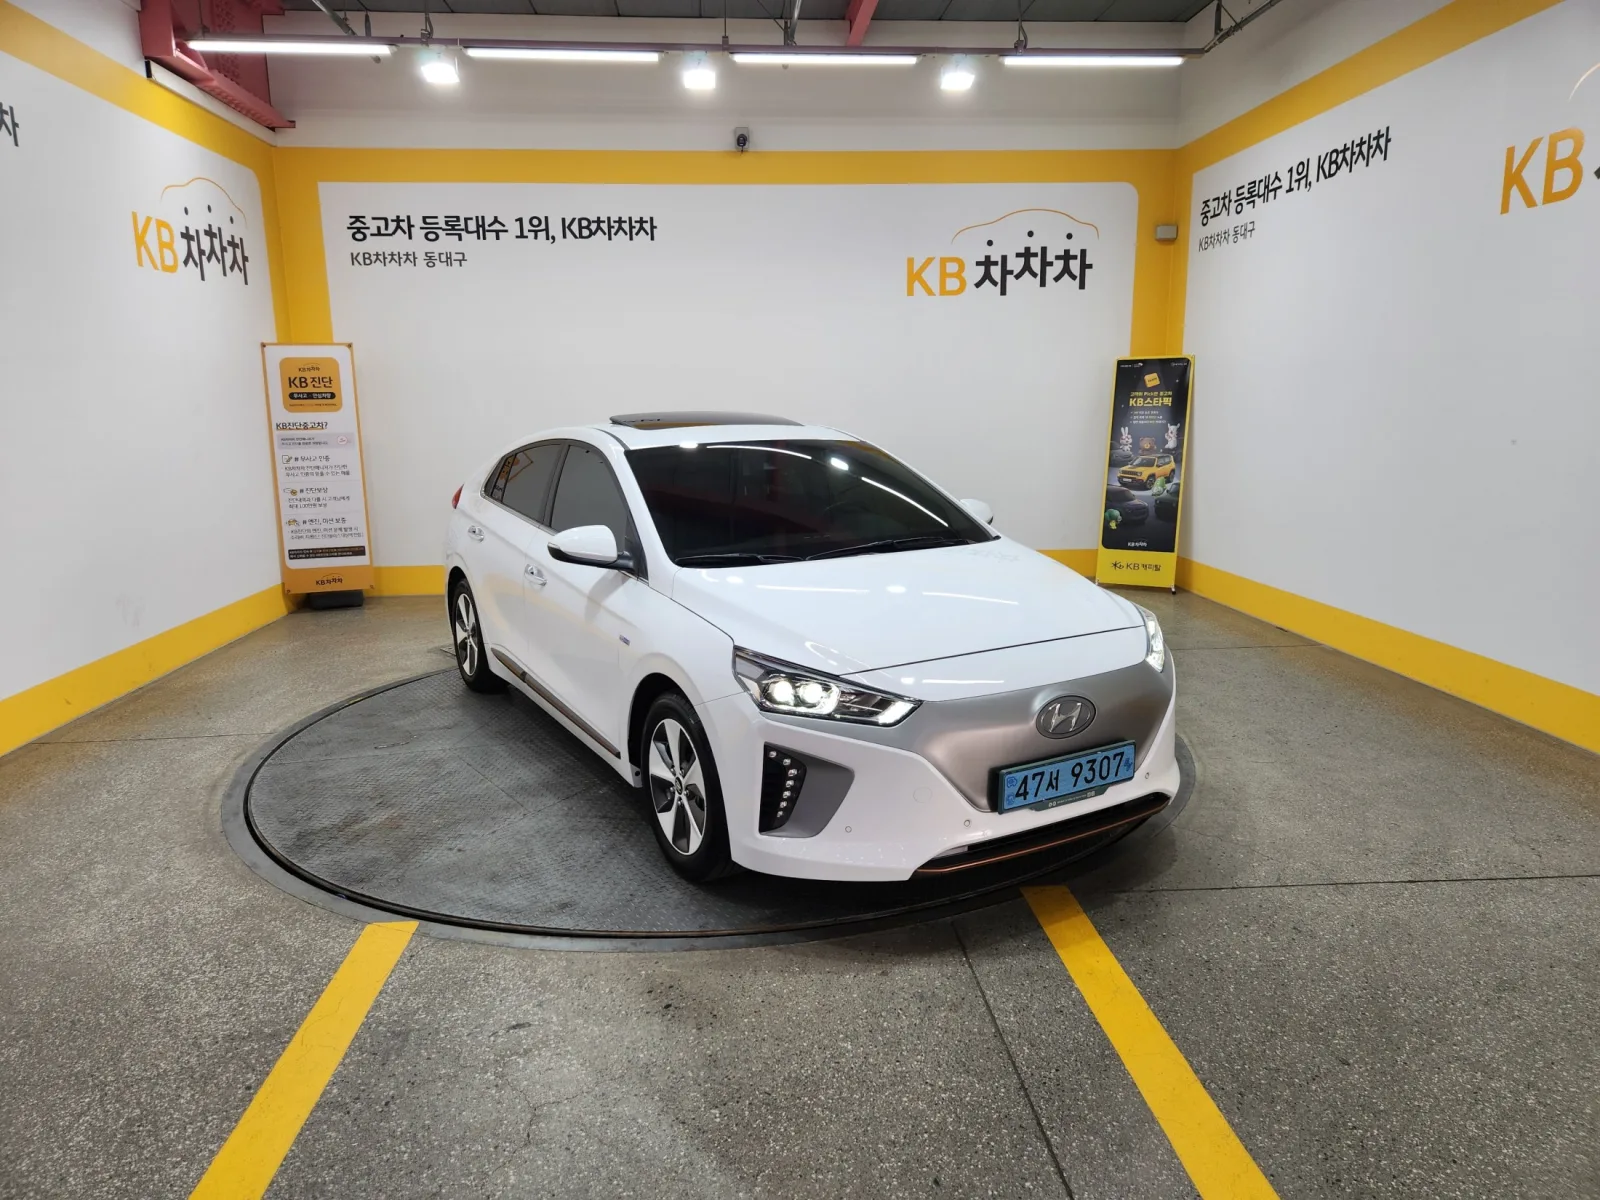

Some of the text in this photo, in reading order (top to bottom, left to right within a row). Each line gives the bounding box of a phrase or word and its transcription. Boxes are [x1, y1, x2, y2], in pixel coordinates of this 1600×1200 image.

[1199, 125, 1392, 227] 중고차 등록대수 1위, KB차차차
[1500, 126, 1585, 215] KB
[346, 214, 658, 244] 중고차 등록대수 1위, KB차차차
[1198, 220, 1256, 252] KB차차차 동대구
[131, 210, 249, 285] KB 차차차
[350, 251, 468, 269] KB차차차 동대구
[906, 240, 1093, 297] KB 차차차
[288, 376, 333, 389] KB 진단
[1129, 397, 1173, 407] KB스타픽
[275, 421, 328, 430] KB진단중고차?
[1126, 562, 1140, 571] KB
[1014, 768, 1060, 801] 47서
[1070, 751, 1126, 788] 9307
